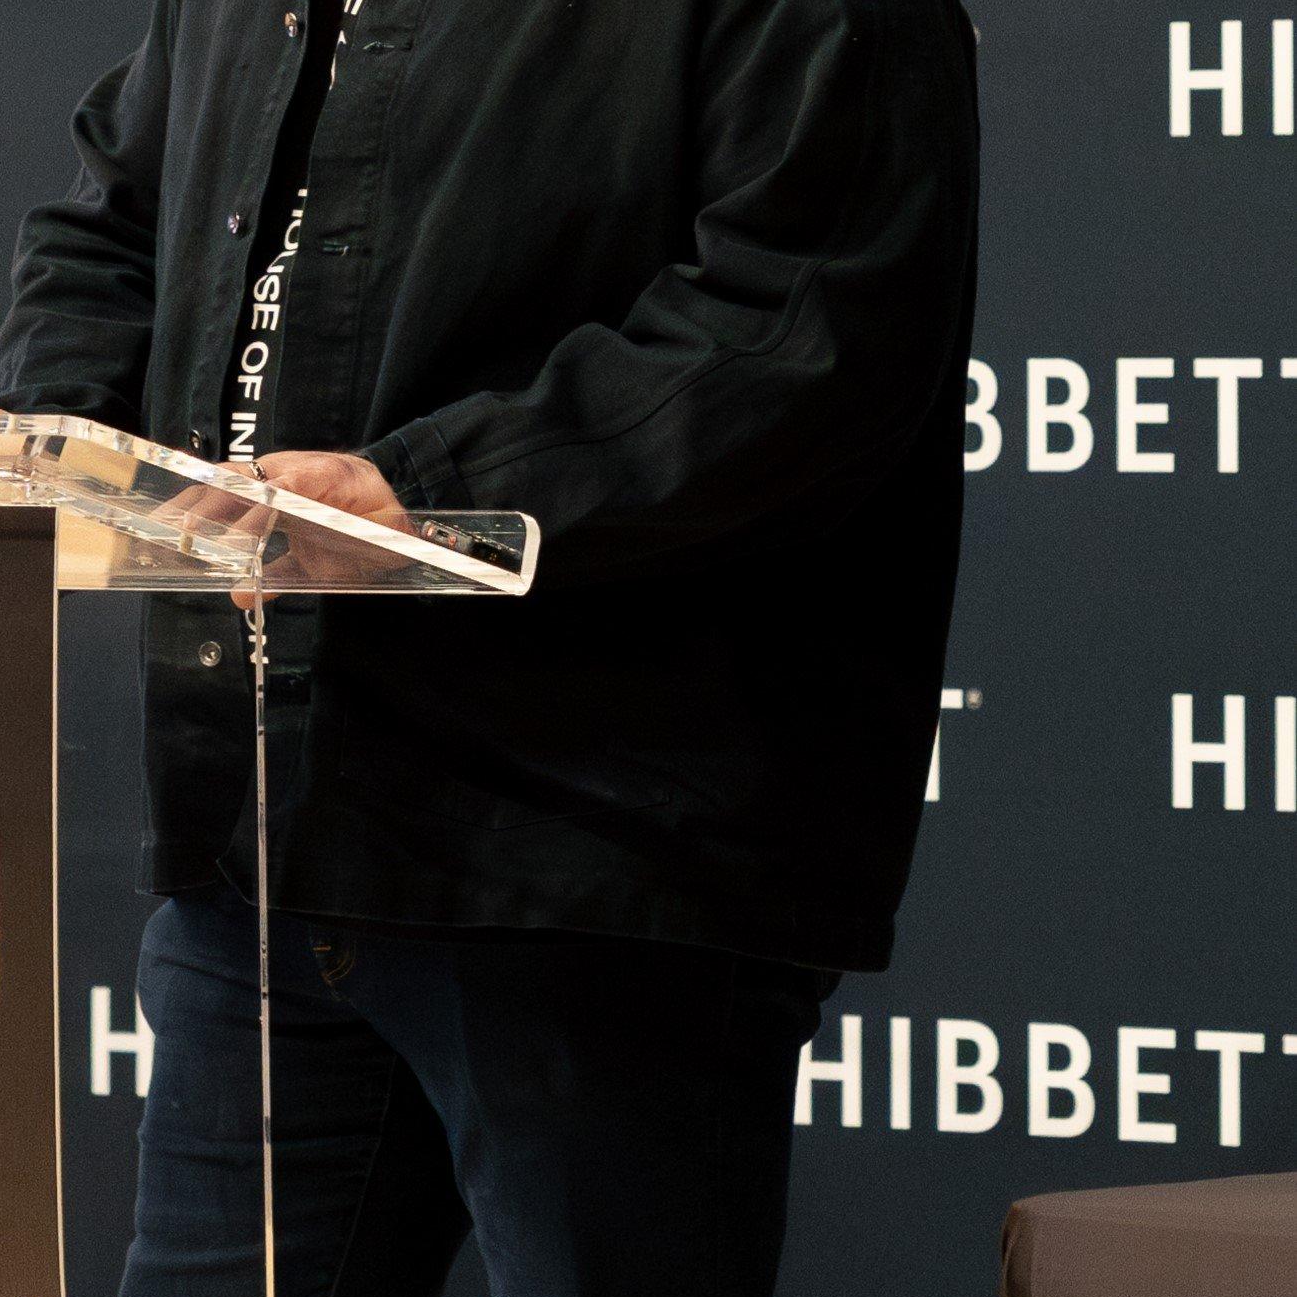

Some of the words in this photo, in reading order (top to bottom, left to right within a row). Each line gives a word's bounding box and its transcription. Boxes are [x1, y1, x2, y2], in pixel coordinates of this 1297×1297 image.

[238, 341, 270, 401] OF
[963, 357, 1297, 474] BBET
[793, 1015, 1297, 1147] HIBBET
